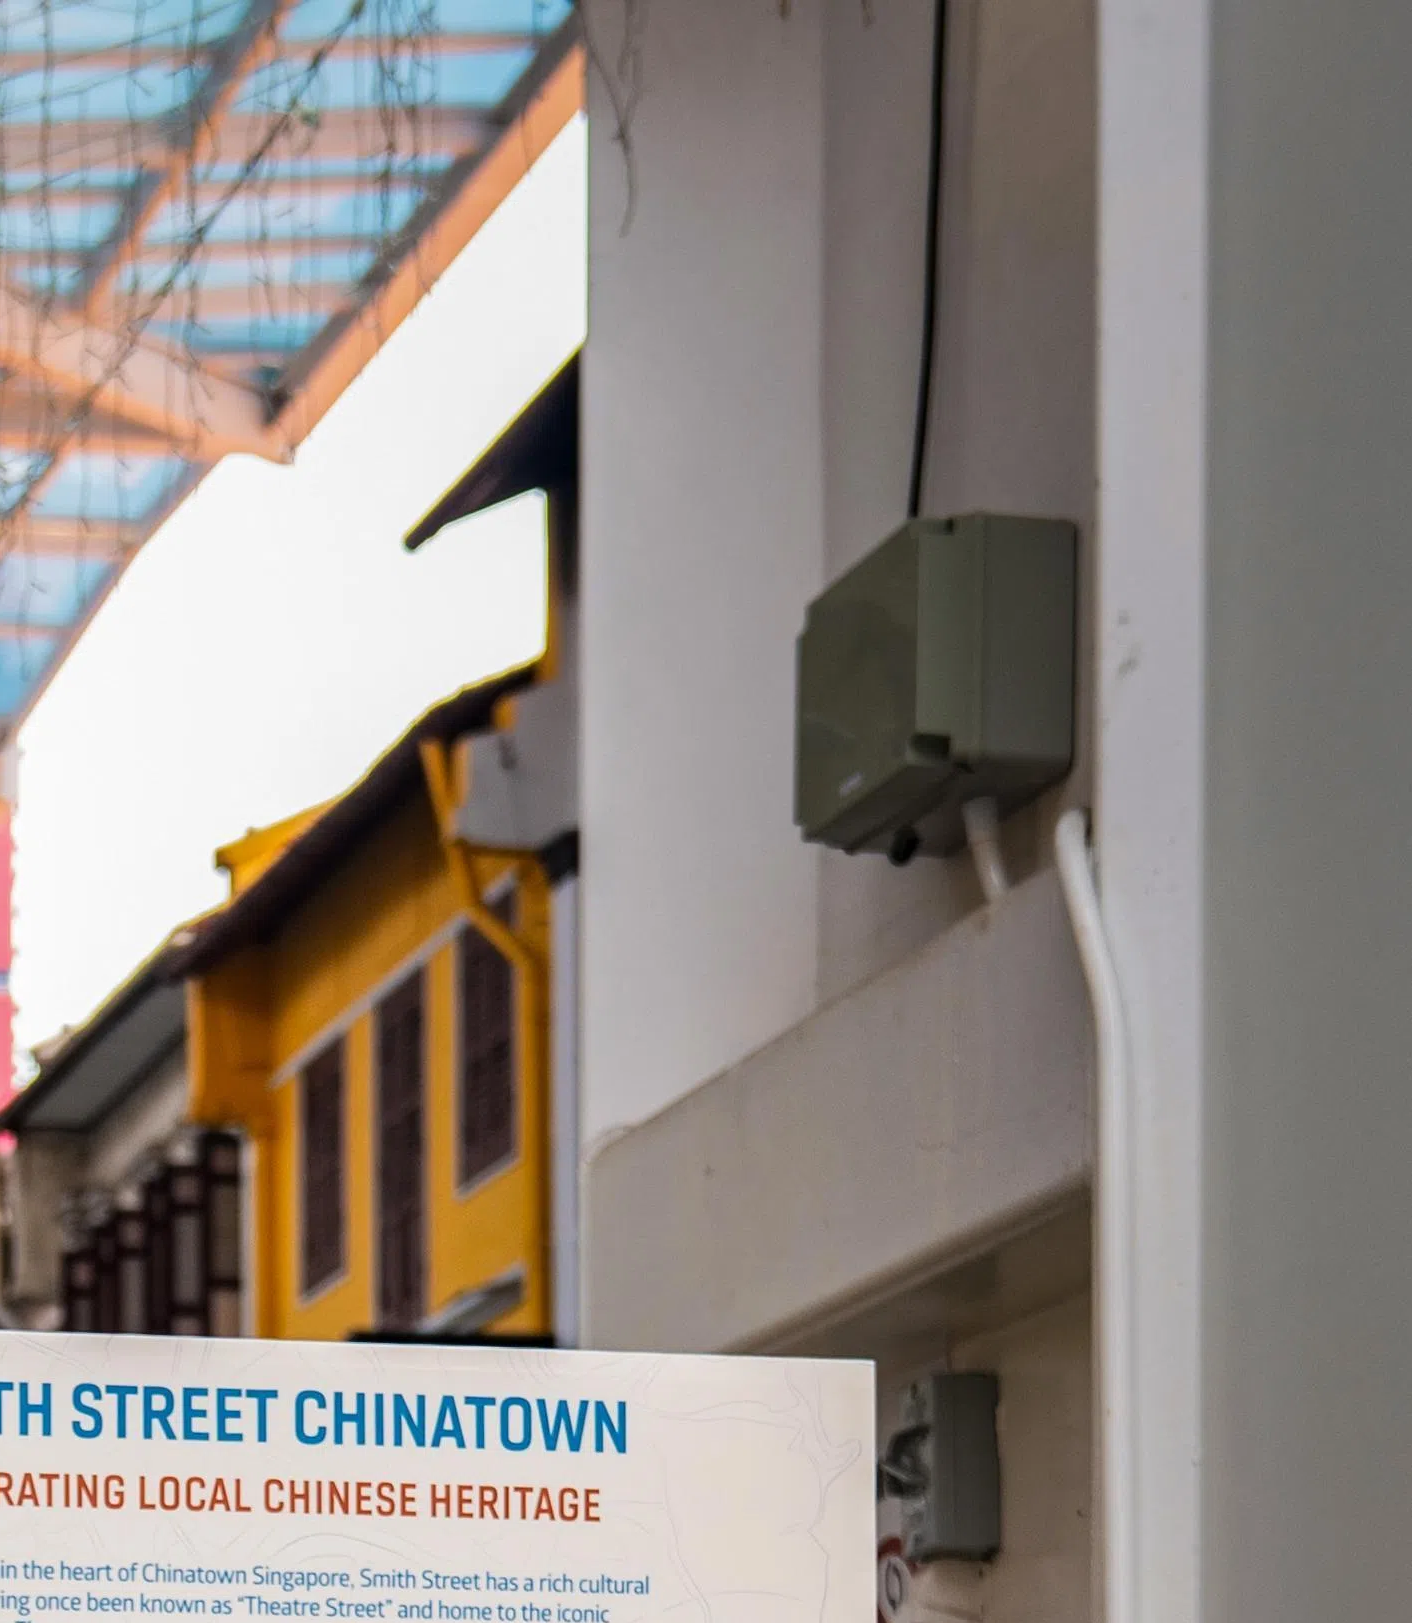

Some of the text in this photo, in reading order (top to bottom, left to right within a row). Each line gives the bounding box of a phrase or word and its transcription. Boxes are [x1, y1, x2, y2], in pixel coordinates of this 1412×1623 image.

[71, 1382, 279, 1443] STREET
[294, 1389, 627, 1454] CHINATOWN
[139, 1475, 252, 1513] LOCAL
[264, 1478, 417, 1517] CHINESE
[430, 1483, 601, 1523] HERITAGE
[22, 1560, 55, 1581] the
[60, 1560, 113, 1582] heart
[117, 1562, 138, 1582] of
[142, 1562, 247, 1585] Chinatown
[252, 1565, 356, 1593] Singapore,
[359, 1568, 417, 1589] Smith
[421, 1569, 481, 1591] Street
[485, 1571, 519, 1592] has
[522, 1577, 534, 1593] a
[539, 1573, 574, 1593] rich
[578, 1574, 650, 1595] cultural
[35, 1595, 82, 1612] once
[86, 1591, 135, 1613] been
[140, 1593, 206, 1614] known
[210, 1599, 233, 1615] as
[397, 1599, 433, 1620] and
[438, 1599, 493, 1621] home
[496, 1604, 517, 1622] to
[520, 1602, 552, 1623] the
[557, 1607, 610, 1623] iconic
